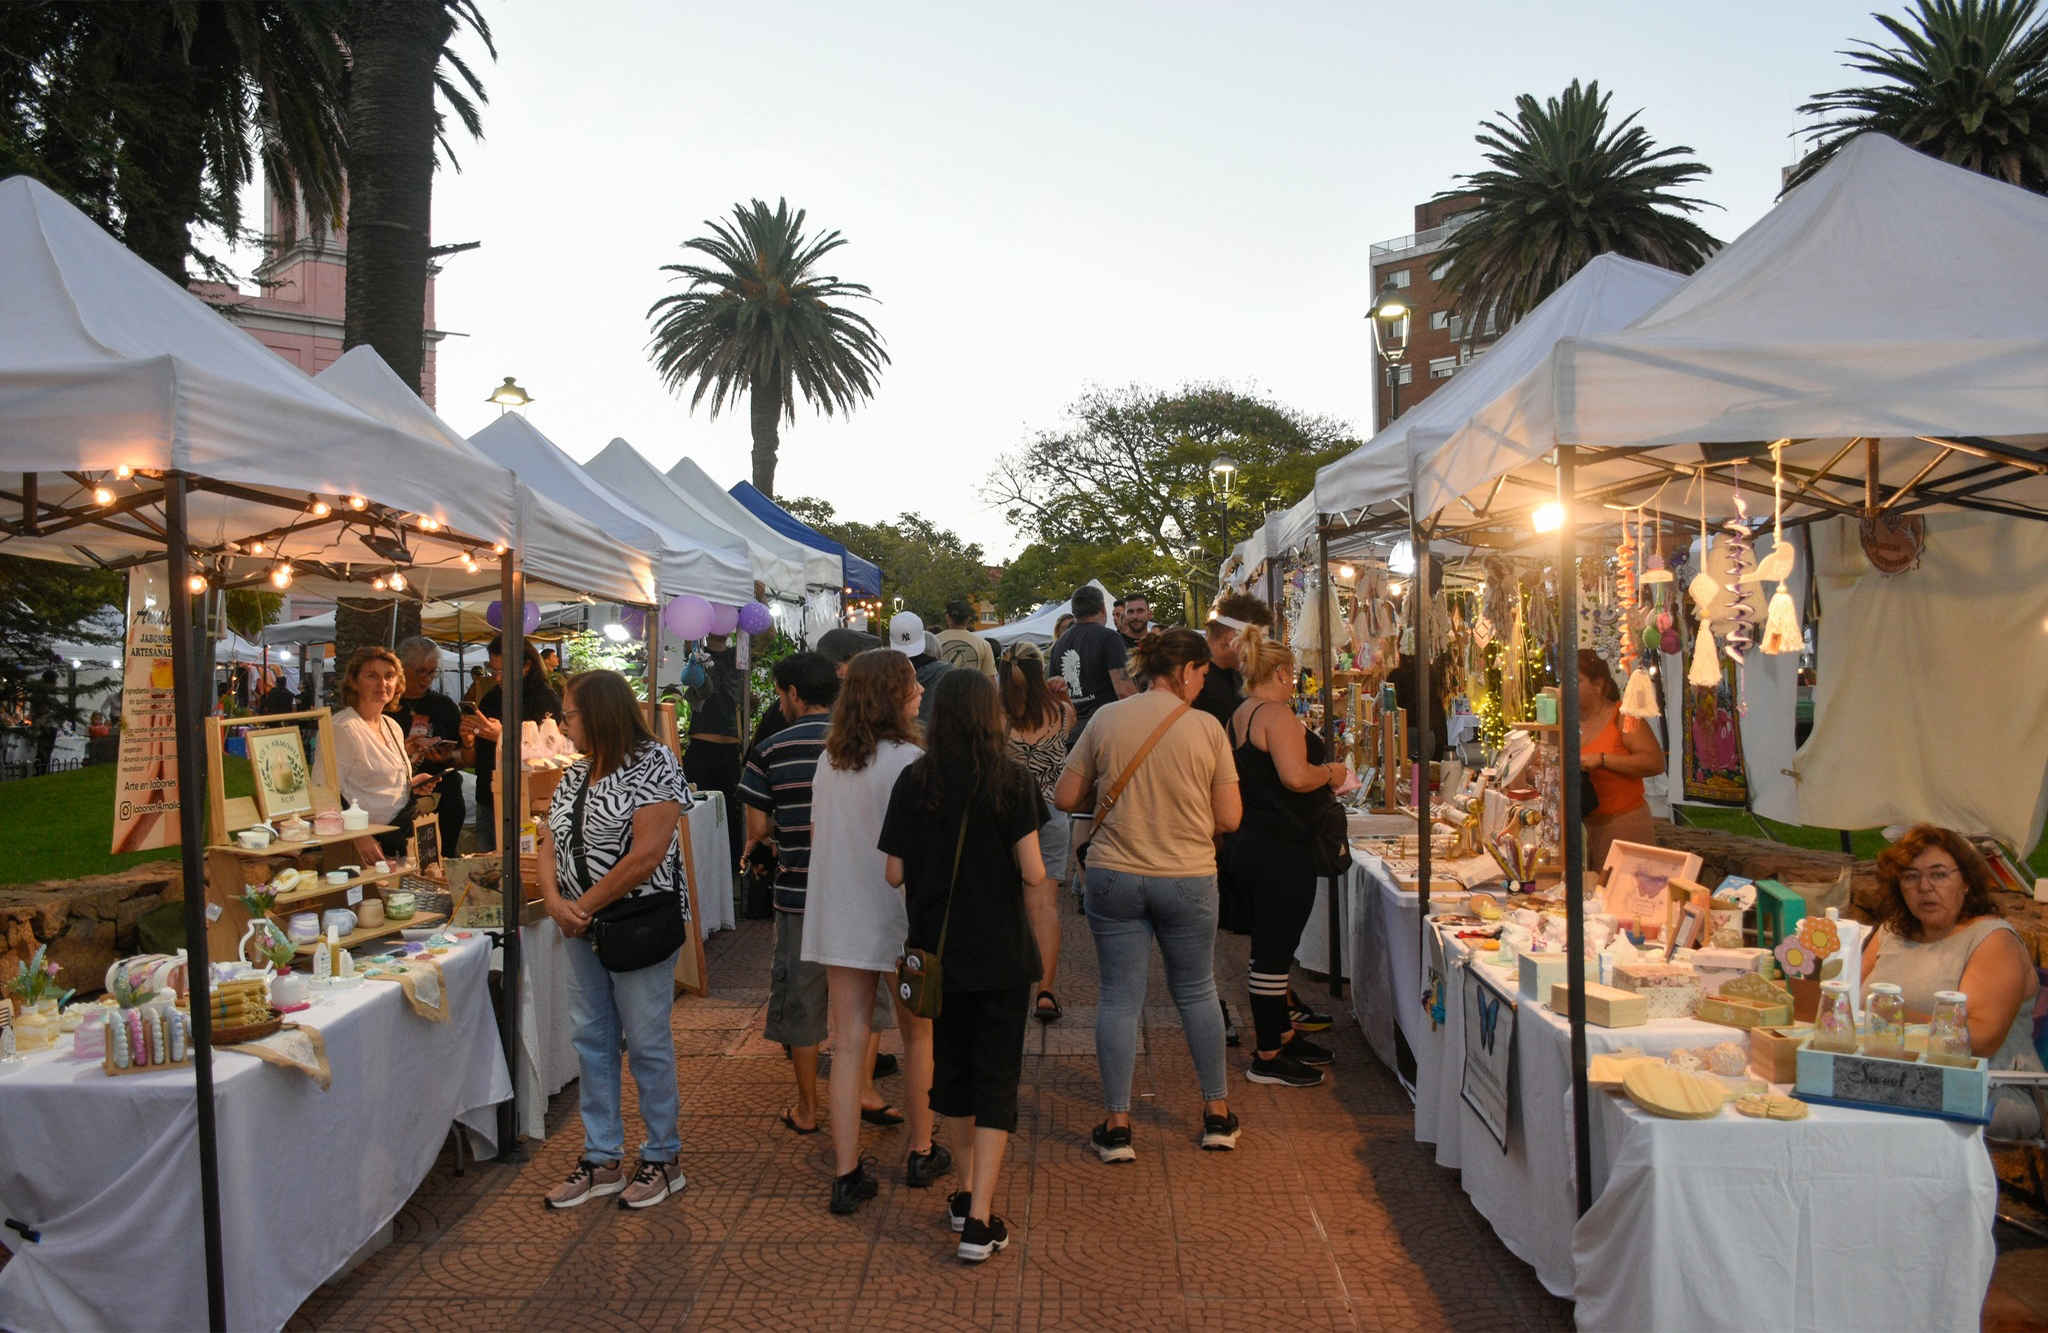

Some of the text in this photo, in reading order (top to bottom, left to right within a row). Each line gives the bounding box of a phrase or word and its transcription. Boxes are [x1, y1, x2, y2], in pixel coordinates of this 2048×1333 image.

[140, 634, 172, 644] JABONES
[125, 779, 177, 791] Arte en Jabones
[1847, 1062, 1908, 1088] Sweet
